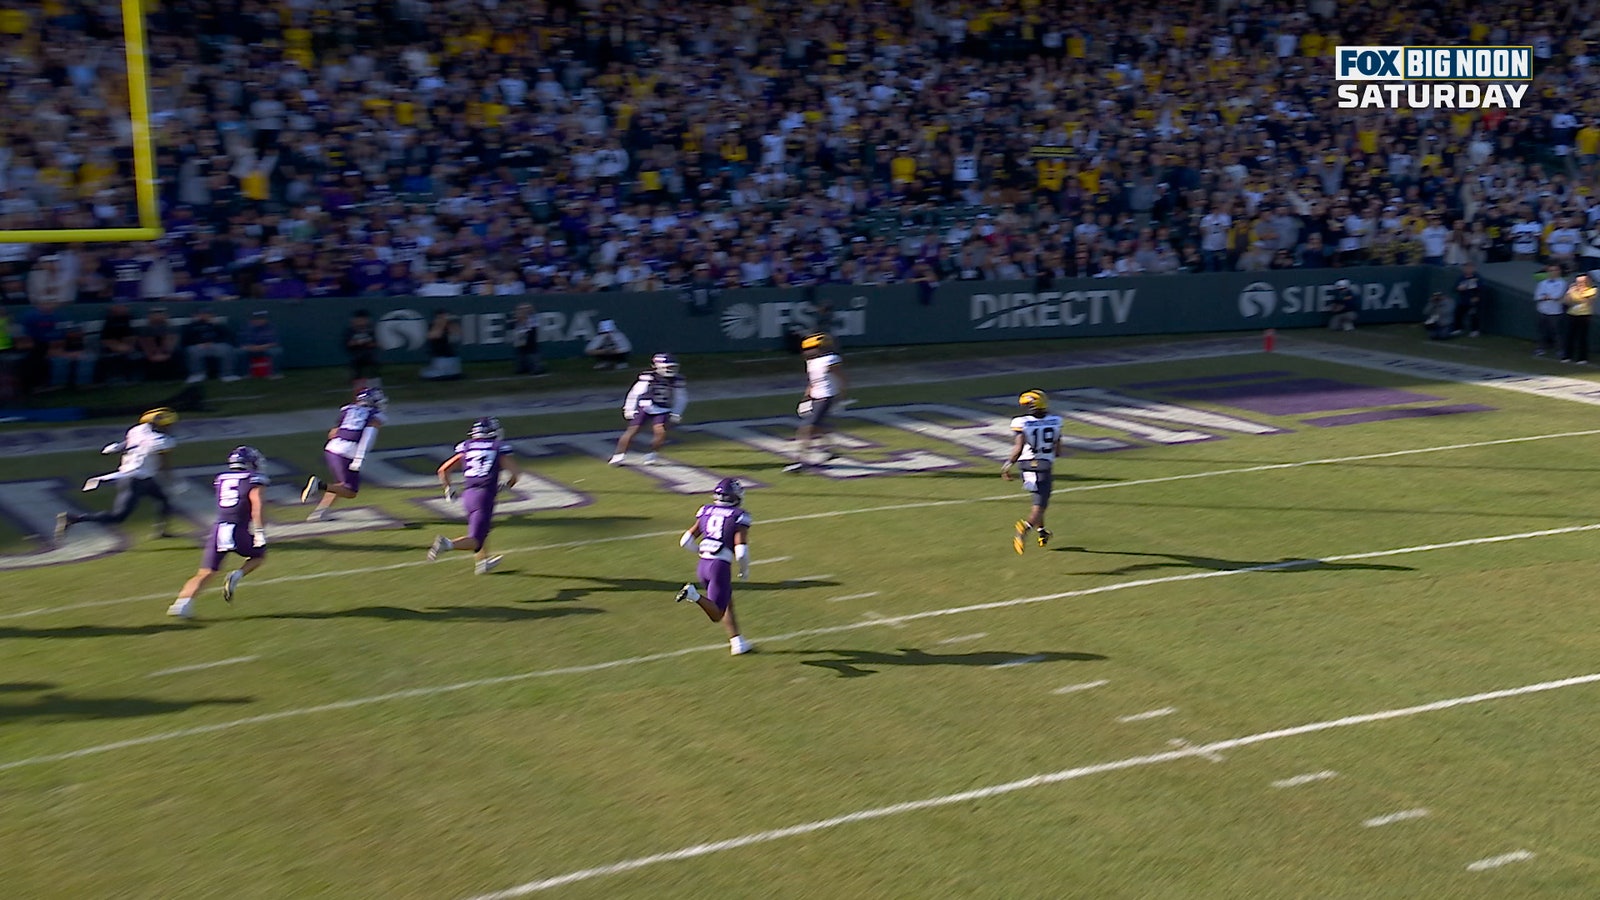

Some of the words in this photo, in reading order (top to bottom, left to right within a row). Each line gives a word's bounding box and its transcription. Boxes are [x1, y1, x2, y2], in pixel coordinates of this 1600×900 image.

[970, 288, 1137, 330] DIRECTV
[1281, 282, 1411, 314] SIERA
[440, 308, 598, 347] IERA
[1030, 427, 1054, 454] 19
[219, 479, 240, 508] 5
[706, 515, 725, 540] 9
